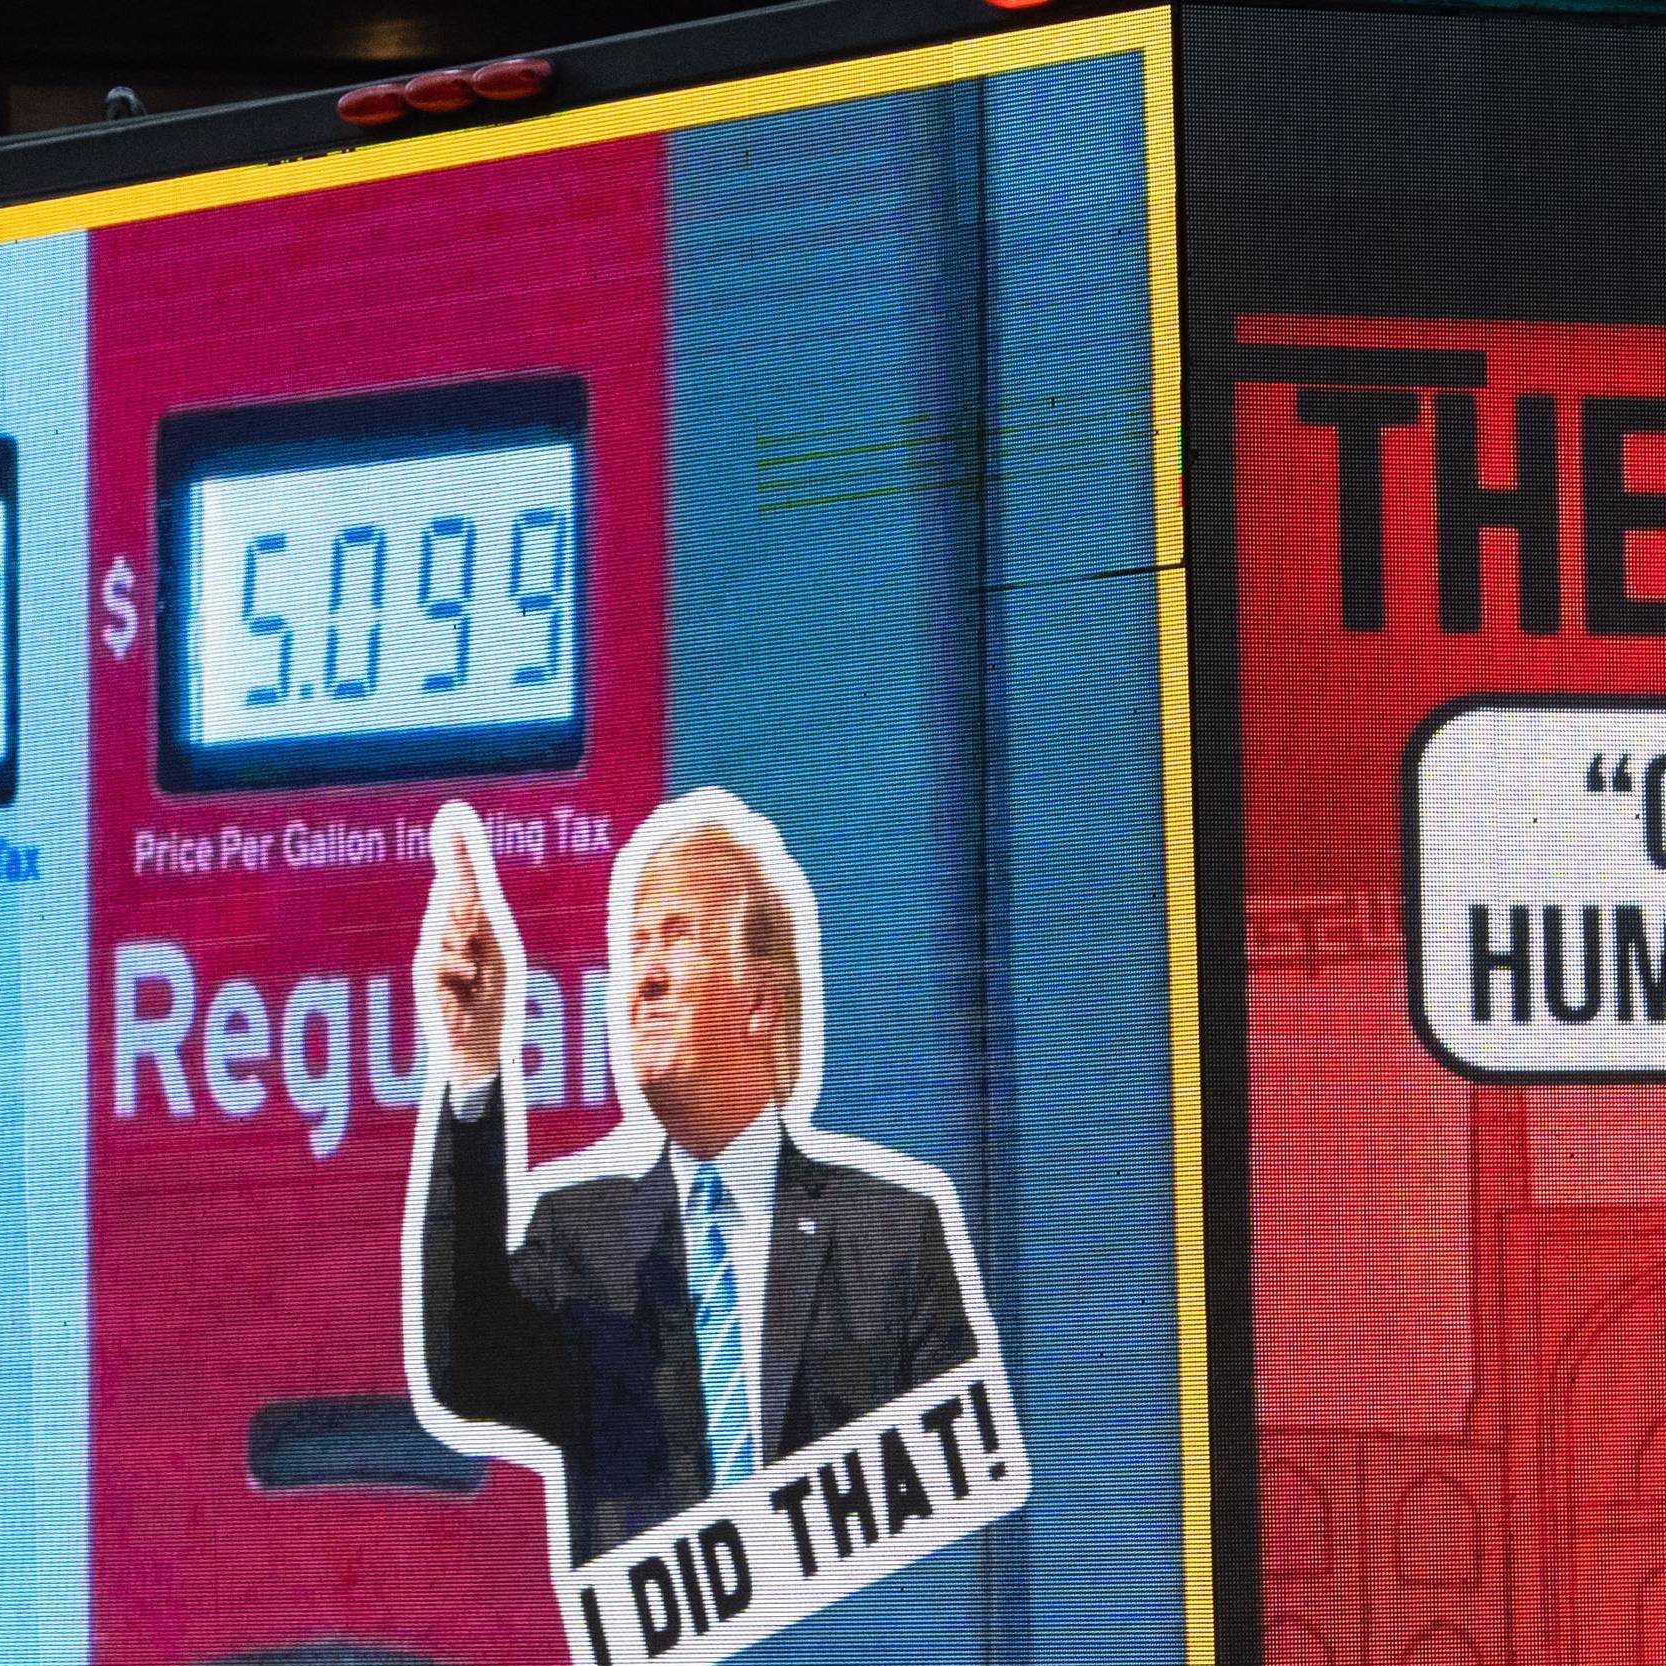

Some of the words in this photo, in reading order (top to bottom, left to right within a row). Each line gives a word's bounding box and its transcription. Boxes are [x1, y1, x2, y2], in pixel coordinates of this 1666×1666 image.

[101, 555, 138, 660] $
[242, 507, 566, 707] 5.099
[135, 830, 209, 875] Price
[219, 825, 273, 871] Per
[283, 820, 386, 869] Gallon
[552, 806, 612, 852] Tax
[113, 938, 612, 1160] Reguar
[628, 1519, 753, 1660] DID
[770, 1379, 1006, 1578] THAT!
